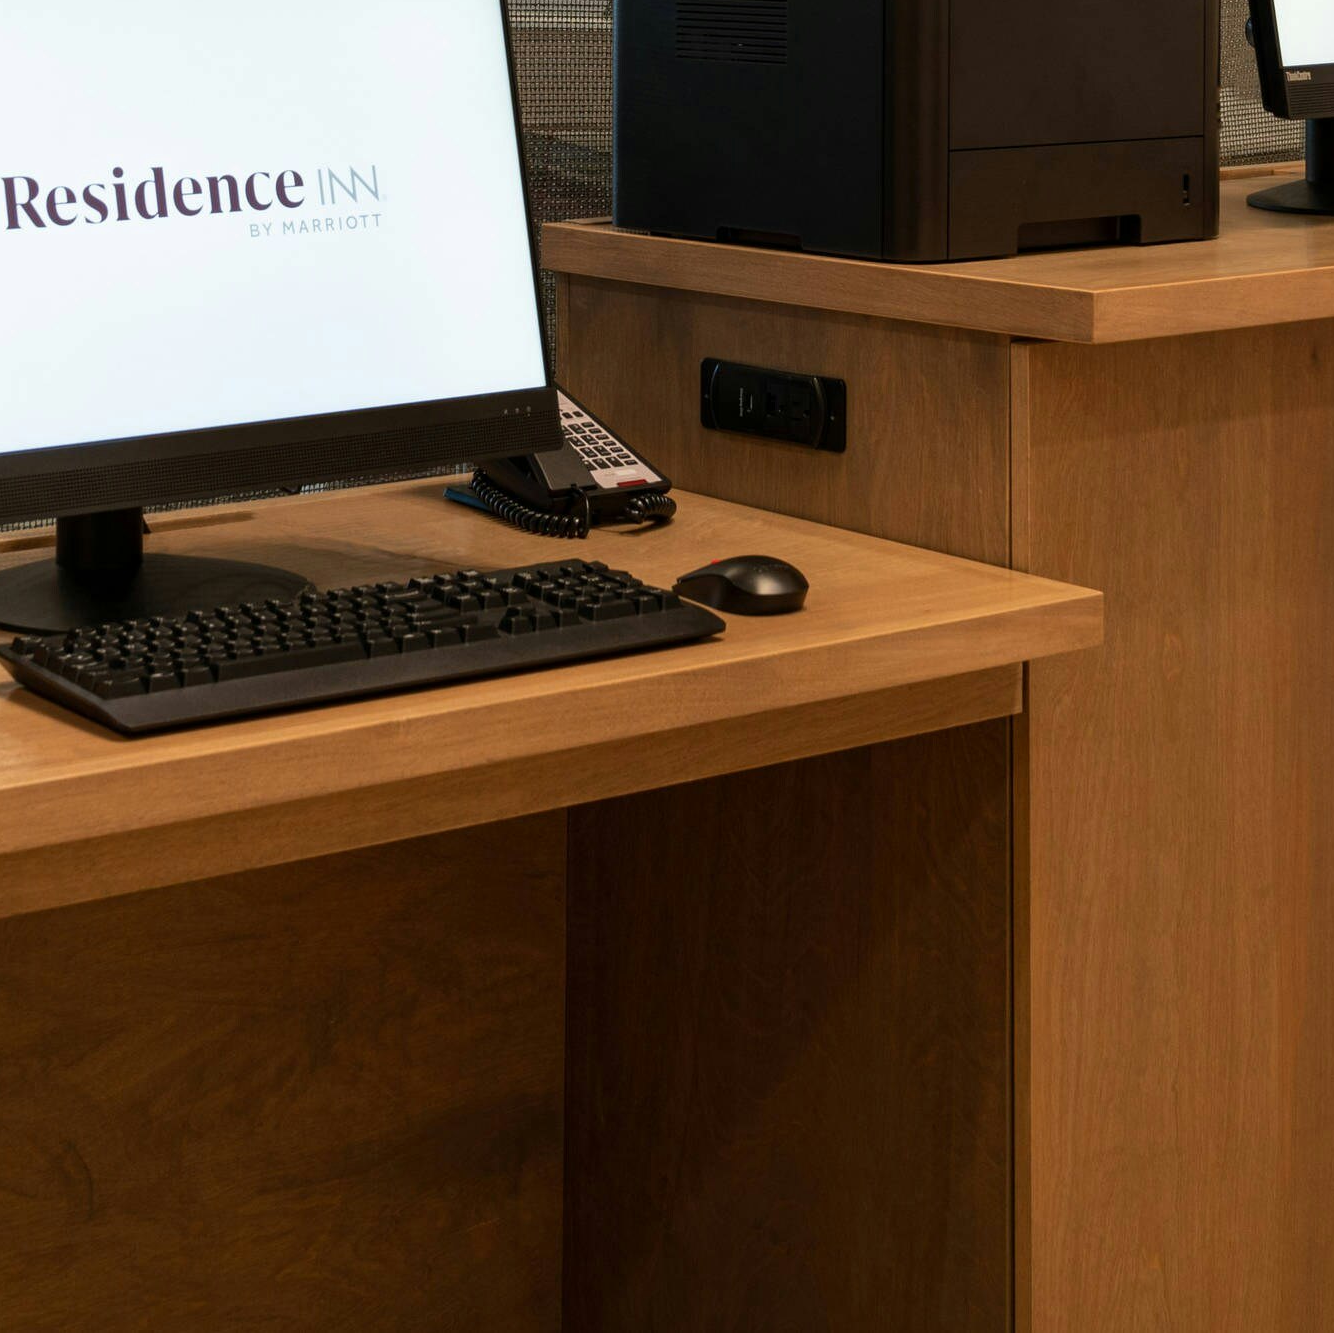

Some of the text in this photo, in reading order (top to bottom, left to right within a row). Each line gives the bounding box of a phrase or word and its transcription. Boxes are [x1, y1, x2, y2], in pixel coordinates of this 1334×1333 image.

[1, 165, 381, 230] Residence INN
[250, 214, 383, 238] BY MARRIOTT
